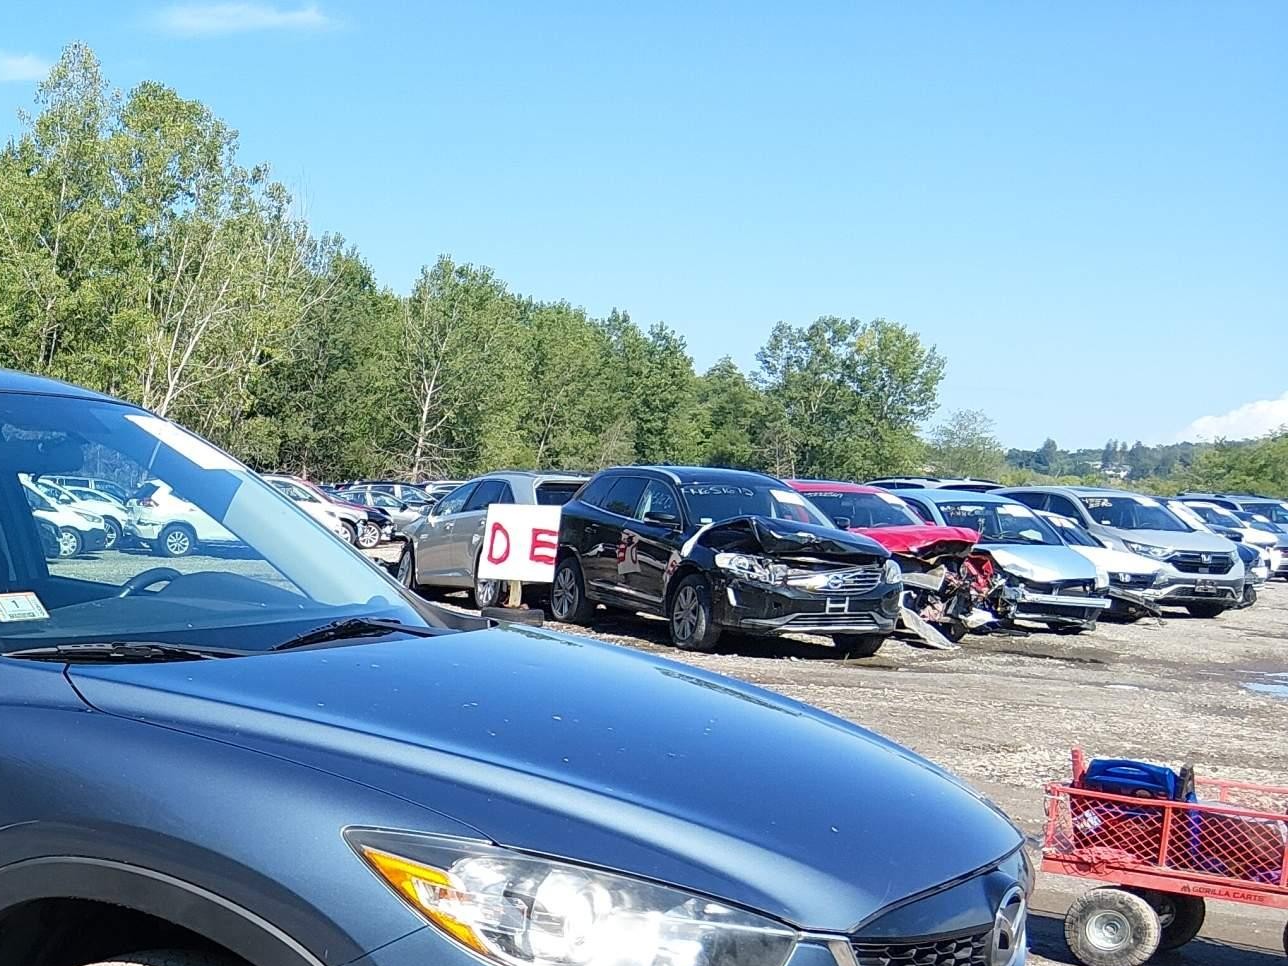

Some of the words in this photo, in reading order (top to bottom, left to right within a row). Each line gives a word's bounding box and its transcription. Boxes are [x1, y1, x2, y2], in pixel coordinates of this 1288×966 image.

[488, 521, 510, 565] D
[529, 527, 558, 565] E
[1192, 886, 1231, 898] GORILLA
[1232, 891, 1265, 902] CARTS
